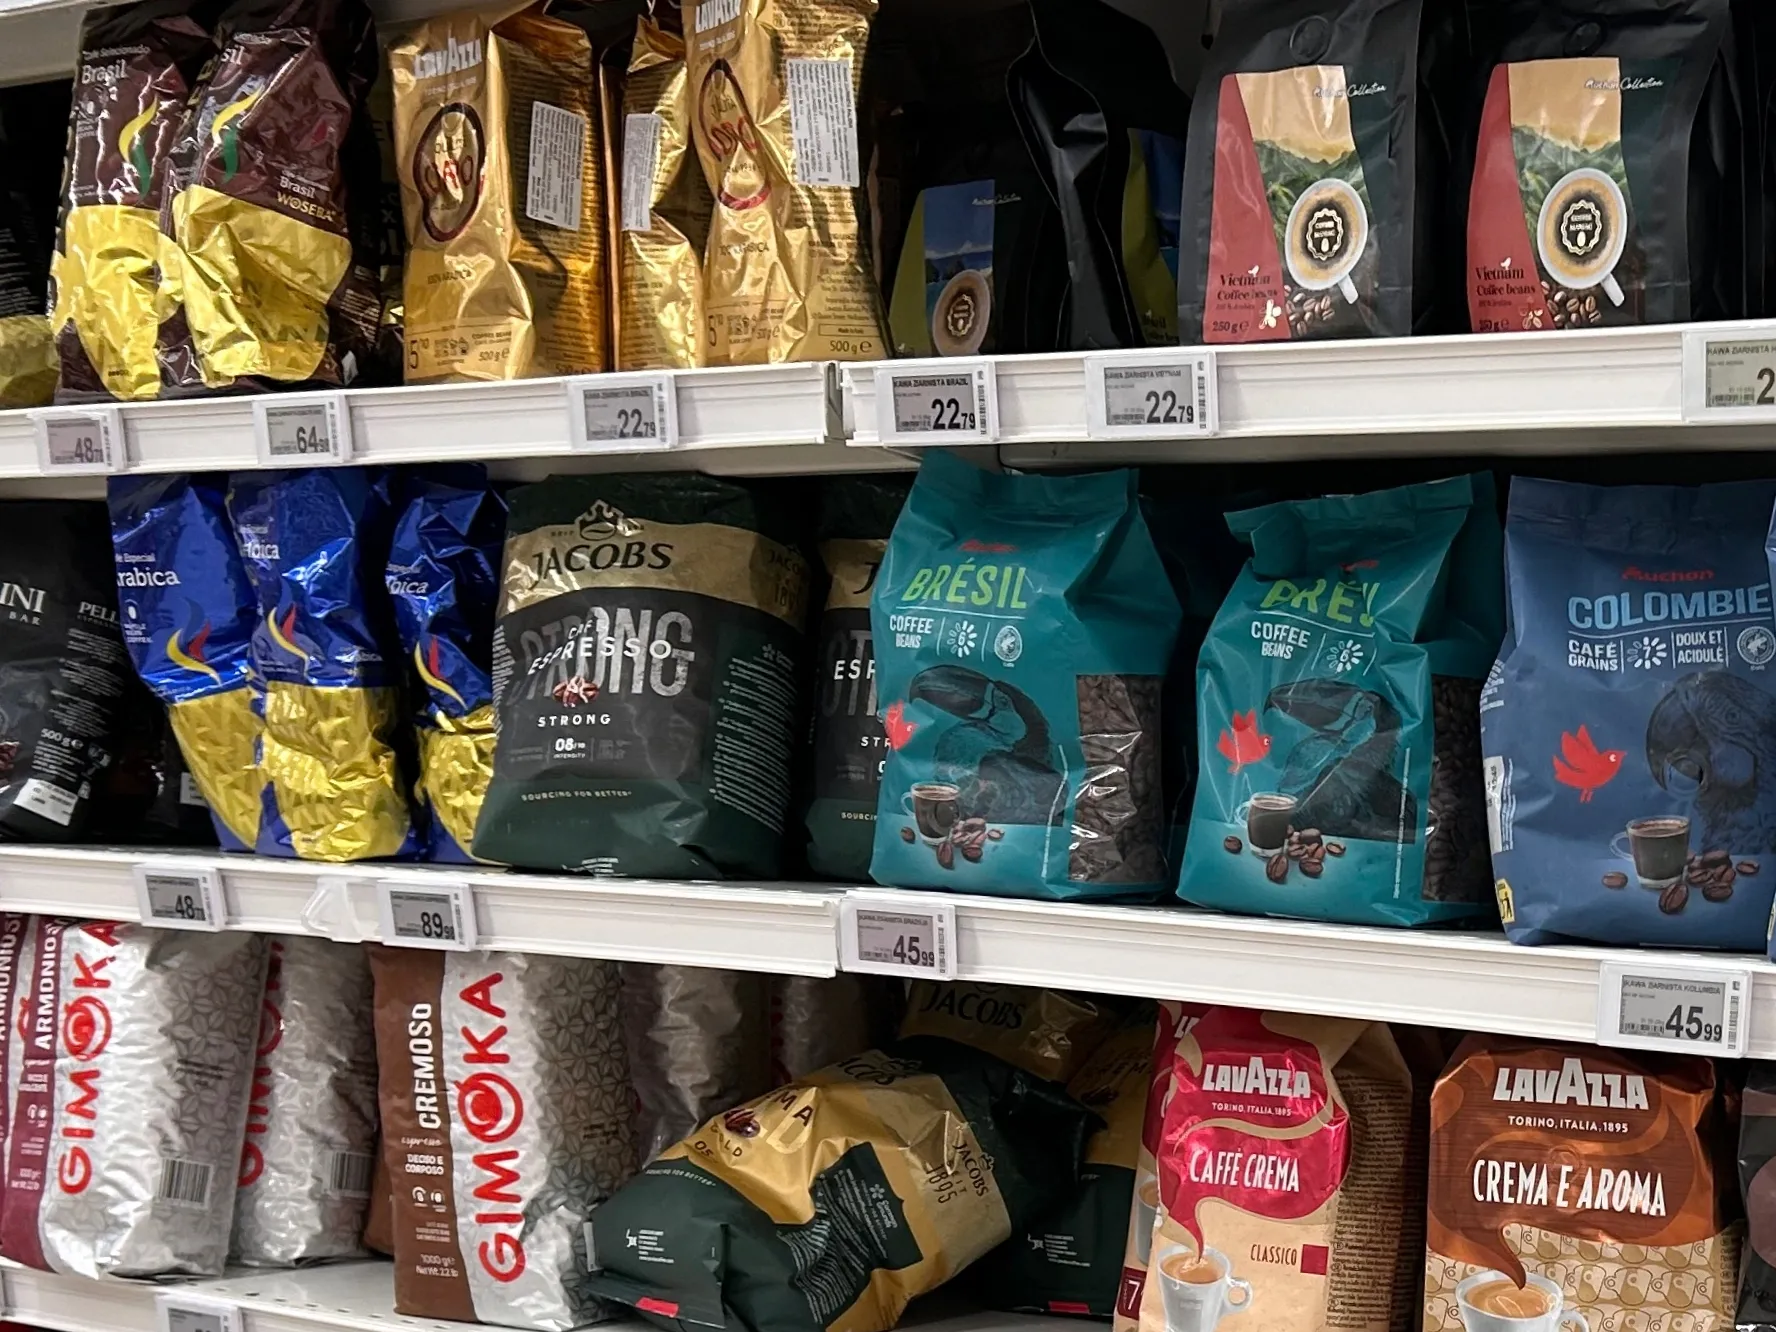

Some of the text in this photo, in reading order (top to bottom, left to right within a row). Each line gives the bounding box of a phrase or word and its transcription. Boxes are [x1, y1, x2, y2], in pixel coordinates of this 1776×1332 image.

[280, 178, 315, 199] Brasil
[1476, 266, 1525, 281] Vietnam
[1477, 284, 1536, 297] Coffee beans
[901, 557, 1027, 609] BRÉSIL
[1568, 582, 1772, 631] COLOMBIE
[890, 615, 933, 633] COFFEE
[1251, 620, 1310, 650] COFFEE
[1568, 638, 1617, 659] CAFÉ
[1677, 630, 1722, 647] DOUX ET
[1261, 642, 1293, 660] BEANS
[1677, 644, 1724, 665] ACIDULÉ
[1568, 653, 1618, 672] GRAINS
[538, 714, 611, 728] STRONG
[920, 984, 1026, 1030] JACOBS
[408, 1002, 442, 1129] CREMOSO
[1202, 1057, 1311, 1099] LAVAZZA
[1493, 1057, 1649, 1110] LAVAZZA
[455, 972, 527, 1282] GIMOKA
[1472, 1158, 1666, 1217] CREMA E AROMA
[1250, 1243, 1297, 1266] CLASSICO
